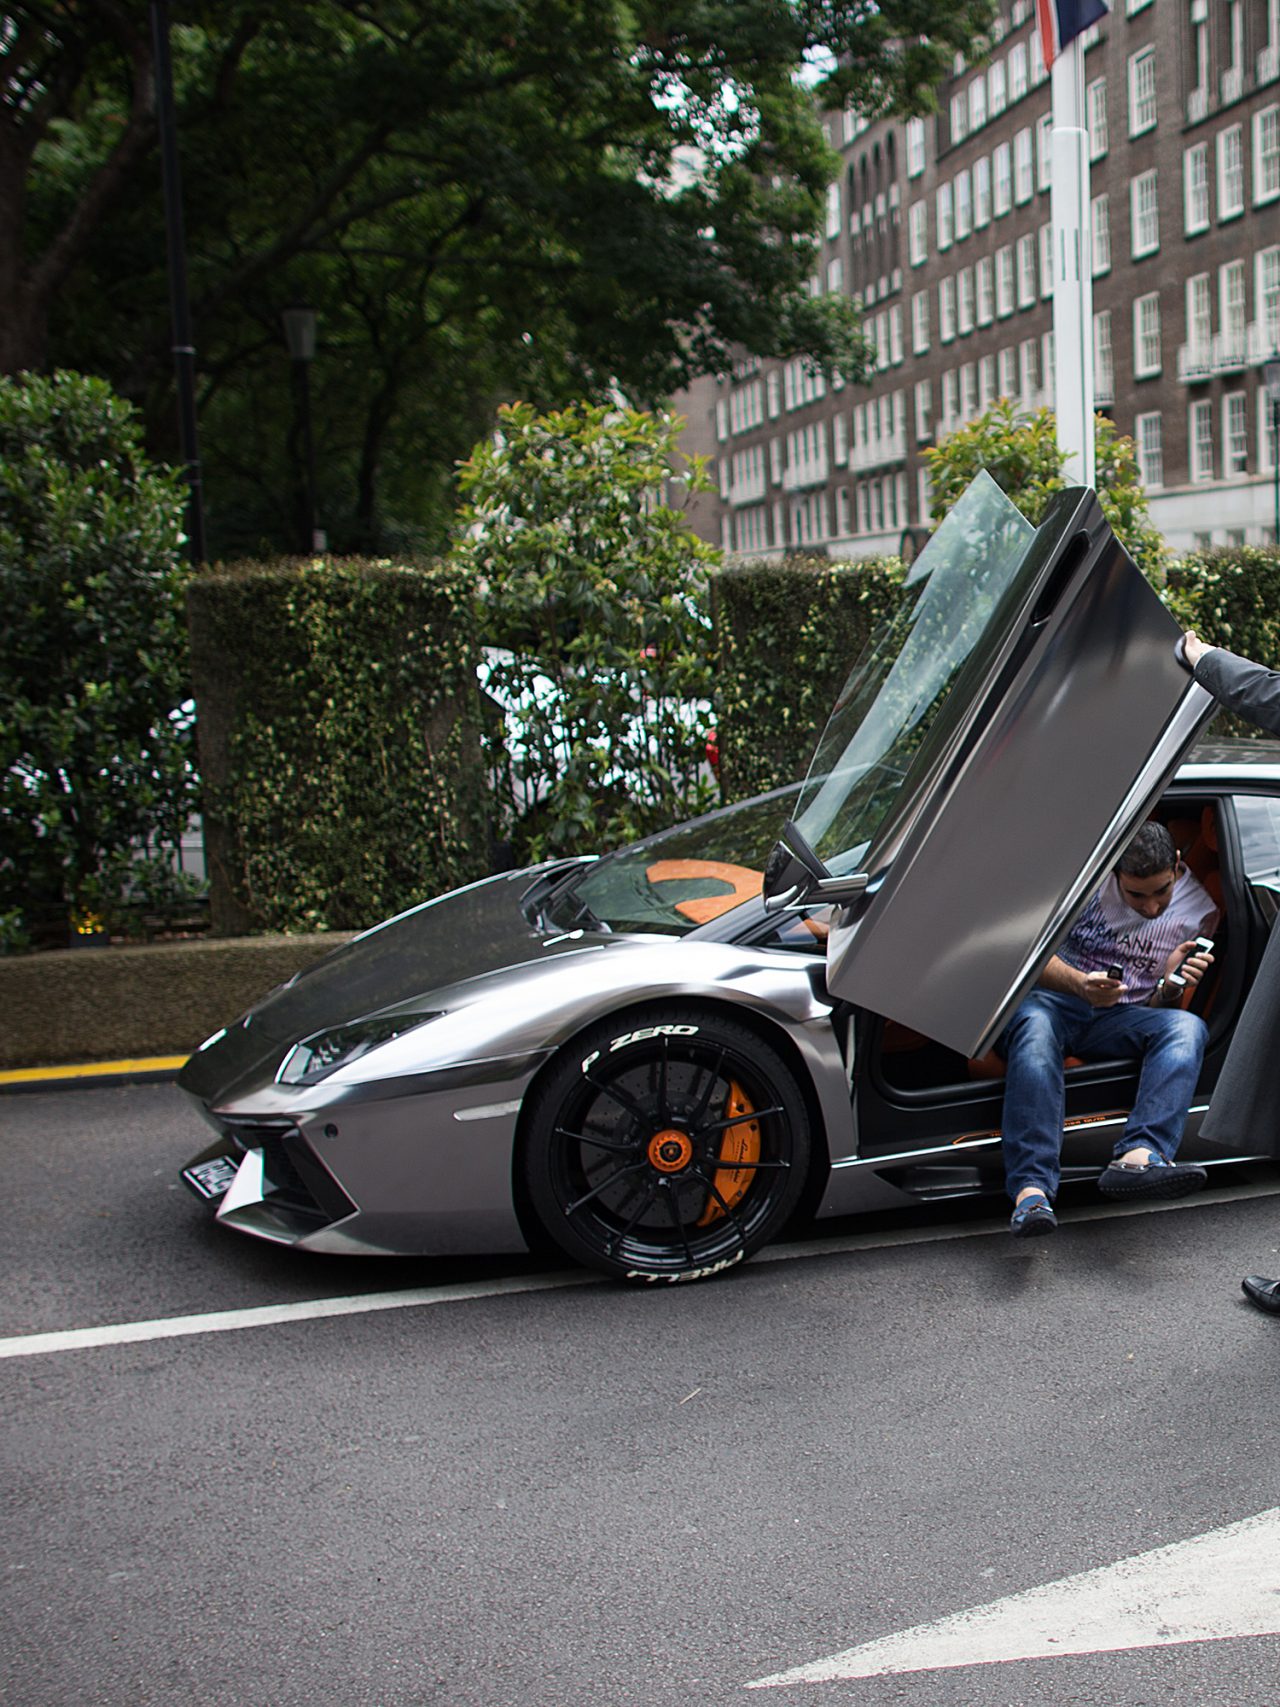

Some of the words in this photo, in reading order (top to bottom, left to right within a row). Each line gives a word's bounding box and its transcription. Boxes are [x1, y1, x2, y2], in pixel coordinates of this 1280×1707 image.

[1079, 920, 1153, 955] ARMANI
[582, 1050, 600, 1073] P
[609, 1024, 699, 1052] ZERO
[626, 1249, 744, 1282] PIRELLI
